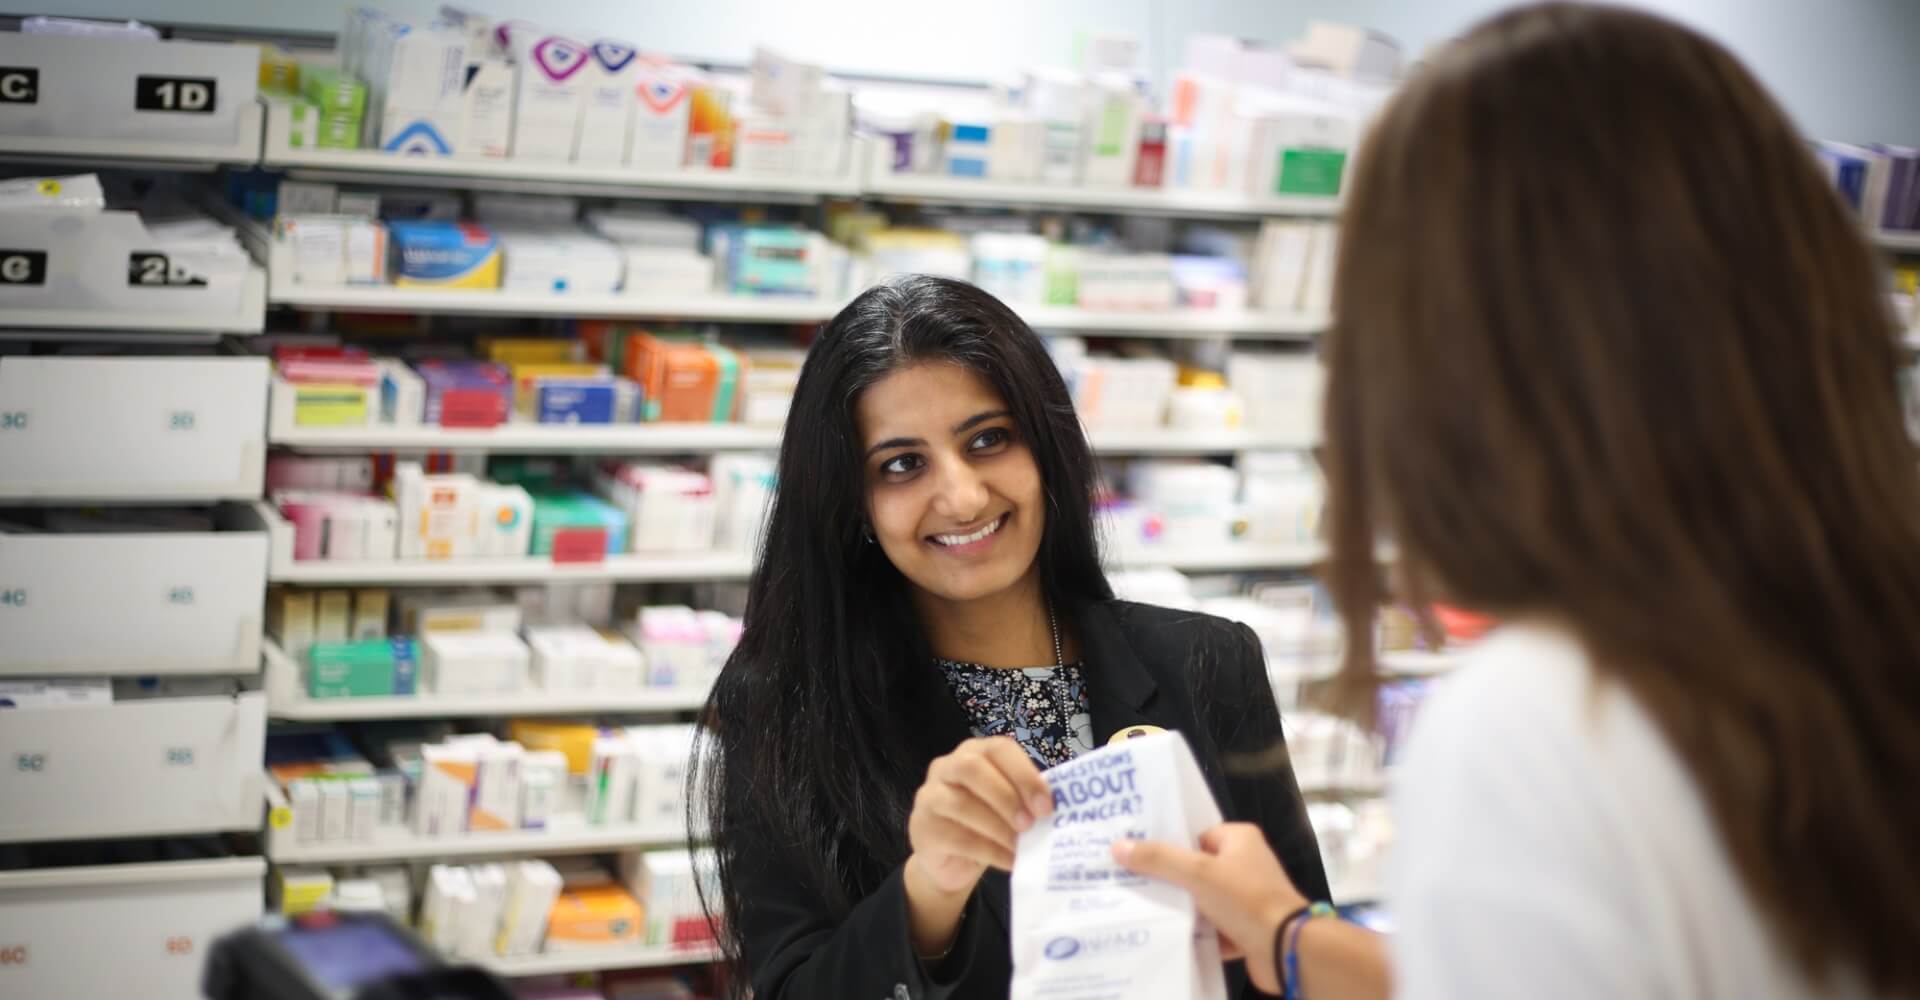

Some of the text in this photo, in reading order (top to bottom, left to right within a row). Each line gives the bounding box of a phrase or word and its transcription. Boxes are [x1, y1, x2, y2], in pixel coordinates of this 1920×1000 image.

[156, 82, 209, 109] 1D
[1052, 767, 1136, 811] ABOUT
[1053, 795, 1143, 828] CANCER?
